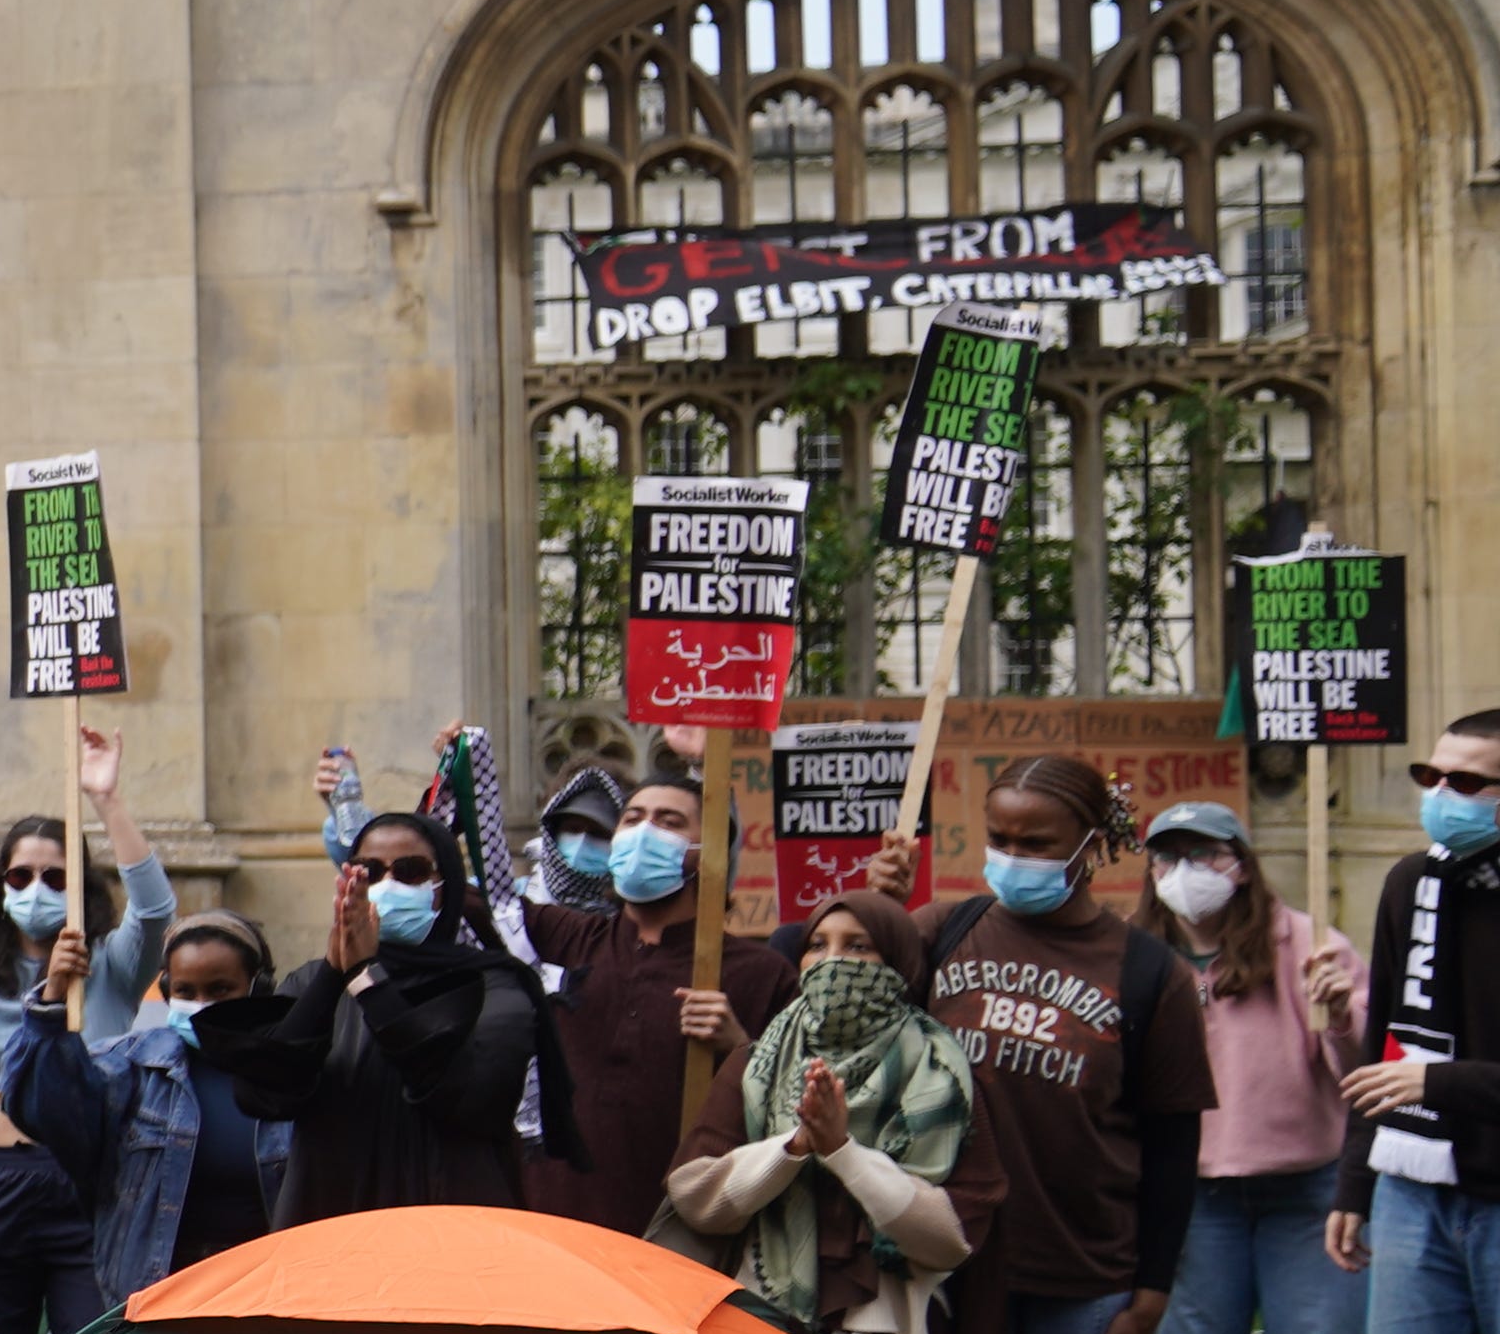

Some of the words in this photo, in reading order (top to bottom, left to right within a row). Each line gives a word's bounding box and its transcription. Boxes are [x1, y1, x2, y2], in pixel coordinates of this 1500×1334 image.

[918, 212, 1077, 263] FROM
[596, 287, 718, 347] DROP
[735, 277, 883, 323] ELBIT,
[957, 308, 1025, 334] Socialist
[936, 331, 1023, 376] FROM
[928, 367, 1015, 411] RIVER
[922, 400, 979, 442] THE
[983, 410, 1023, 449] SE
[24, 487, 76, 524] FROM
[82, 483, 101, 517] TH
[661, 485, 734, 503] Socialist
[734, 486, 791, 505] Worker
[906, 469, 974, 514] WILL
[26, 520, 78, 556] RIVER
[85, 517, 101, 552] TO
[650, 513, 795, 558] FREEDOM
[900, 504, 973, 549] FREE
[26, 557, 61, 590] THE
[65, 553, 100, 586] SEA
[711, 553, 739, 574] for
[1252, 559, 1325, 591] FROM
[1332, 557, 1383, 589] THE
[28, 583, 116, 626] PALESTINE
[640, 571, 795, 618] PALESTINE
[1252, 589, 1327, 621] RIVER
[1333, 589, 1371, 619] TO
[27, 623, 72, 659] WILL
[77, 620, 101, 656] BE
[665, 628, 773, 670] الحرية
[1253, 620, 1301, 651] THE
[1307, 619, 1360, 649] SEA
[27, 656, 74, 693] FREE
[1253, 648, 1392, 681] PALESTINE
[1253, 680, 1318, 711] WILL
[1321, 679, 1358, 710] BE
[1257, 710, 1319, 742] FREE
[787, 750, 914, 787] FREEDOM
[840, 784, 865, 800] for
[782, 797, 918, 835] PALESTIN
[1403, 875, 1442, 1011] FREE
[934, 959, 1125, 1035] ABERCROMBIE
[979, 991, 1060, 1043] 1892
[955, 1027, 988, 1065] ND
[994, 1035, 1086, 1087] FITCH
